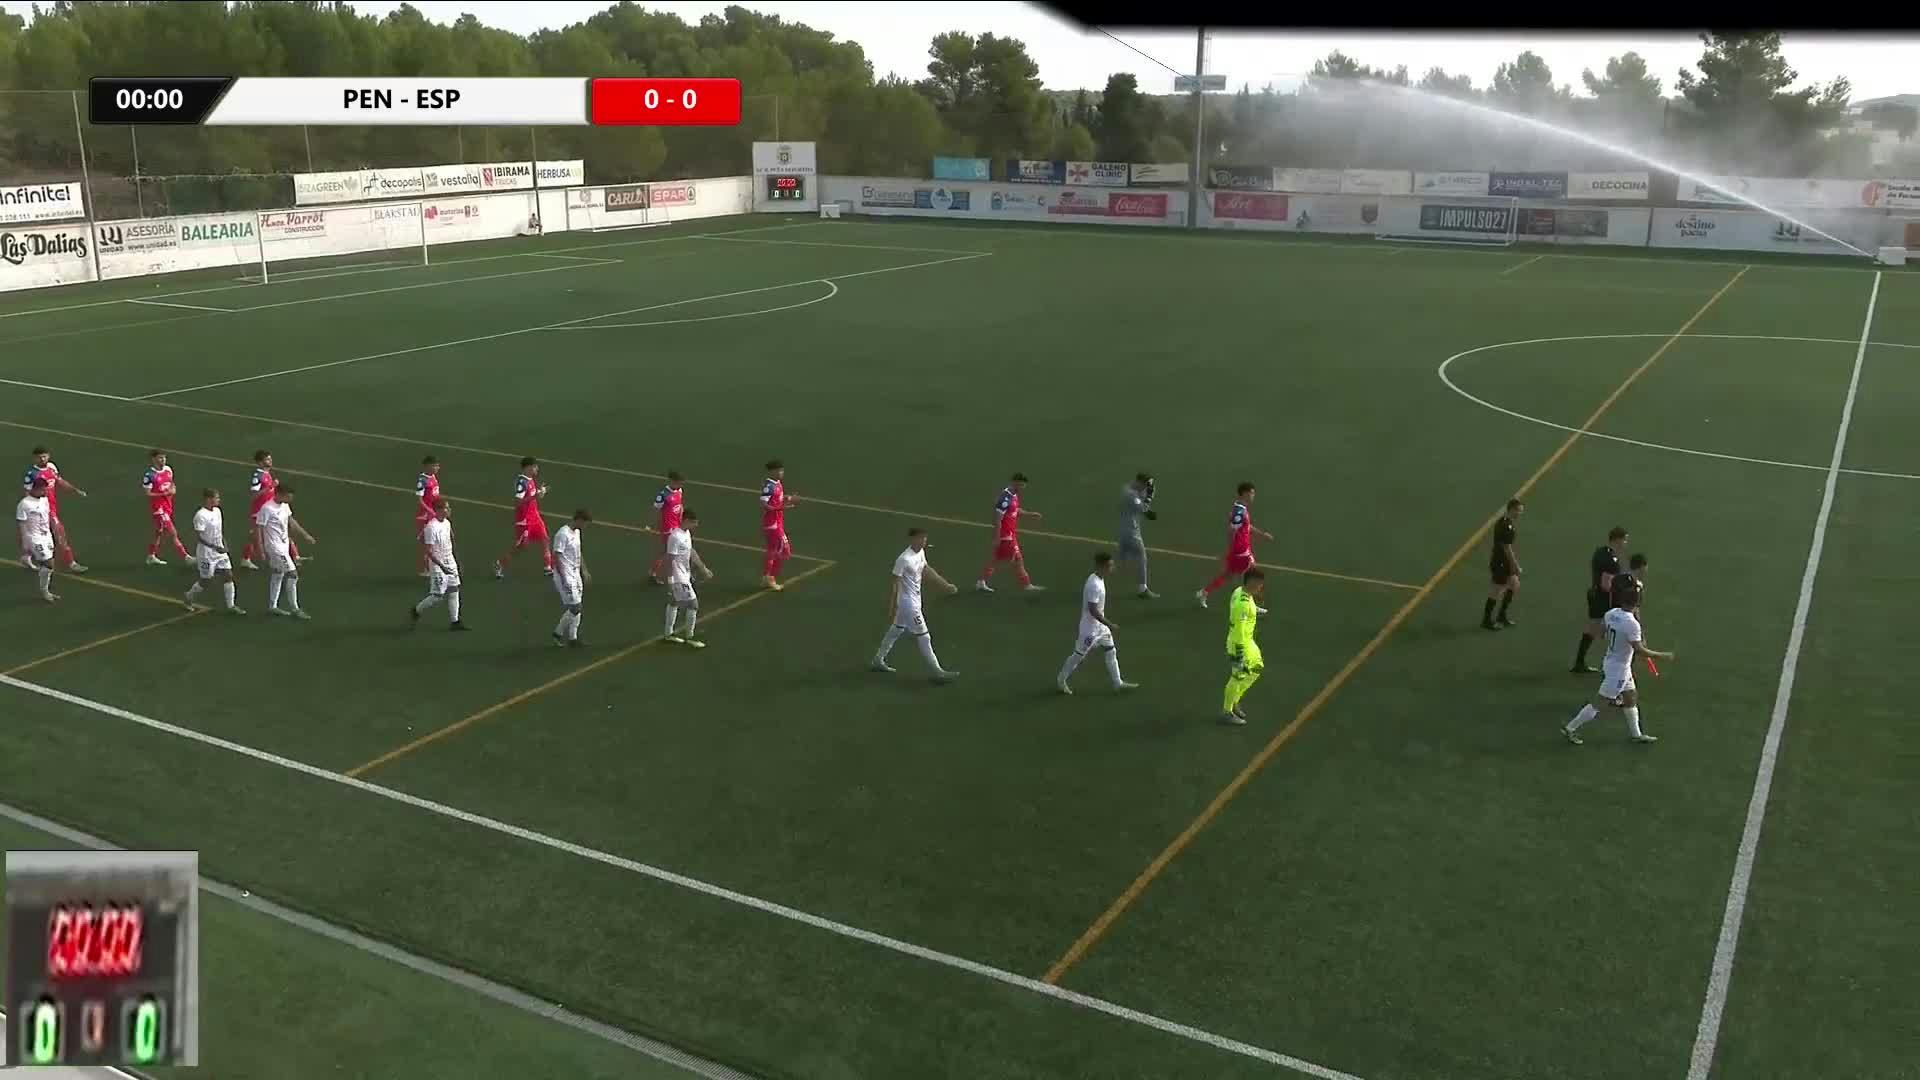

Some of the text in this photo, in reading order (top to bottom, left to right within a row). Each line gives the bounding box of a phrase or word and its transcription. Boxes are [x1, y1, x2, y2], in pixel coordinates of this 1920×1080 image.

[493, 165, 531, 177] IBIRAMA
[537, 168, 571, 179] HERBUSA
[653, 188, 686, 201] SPAR
[26, 233, 88, 258] Dalias
